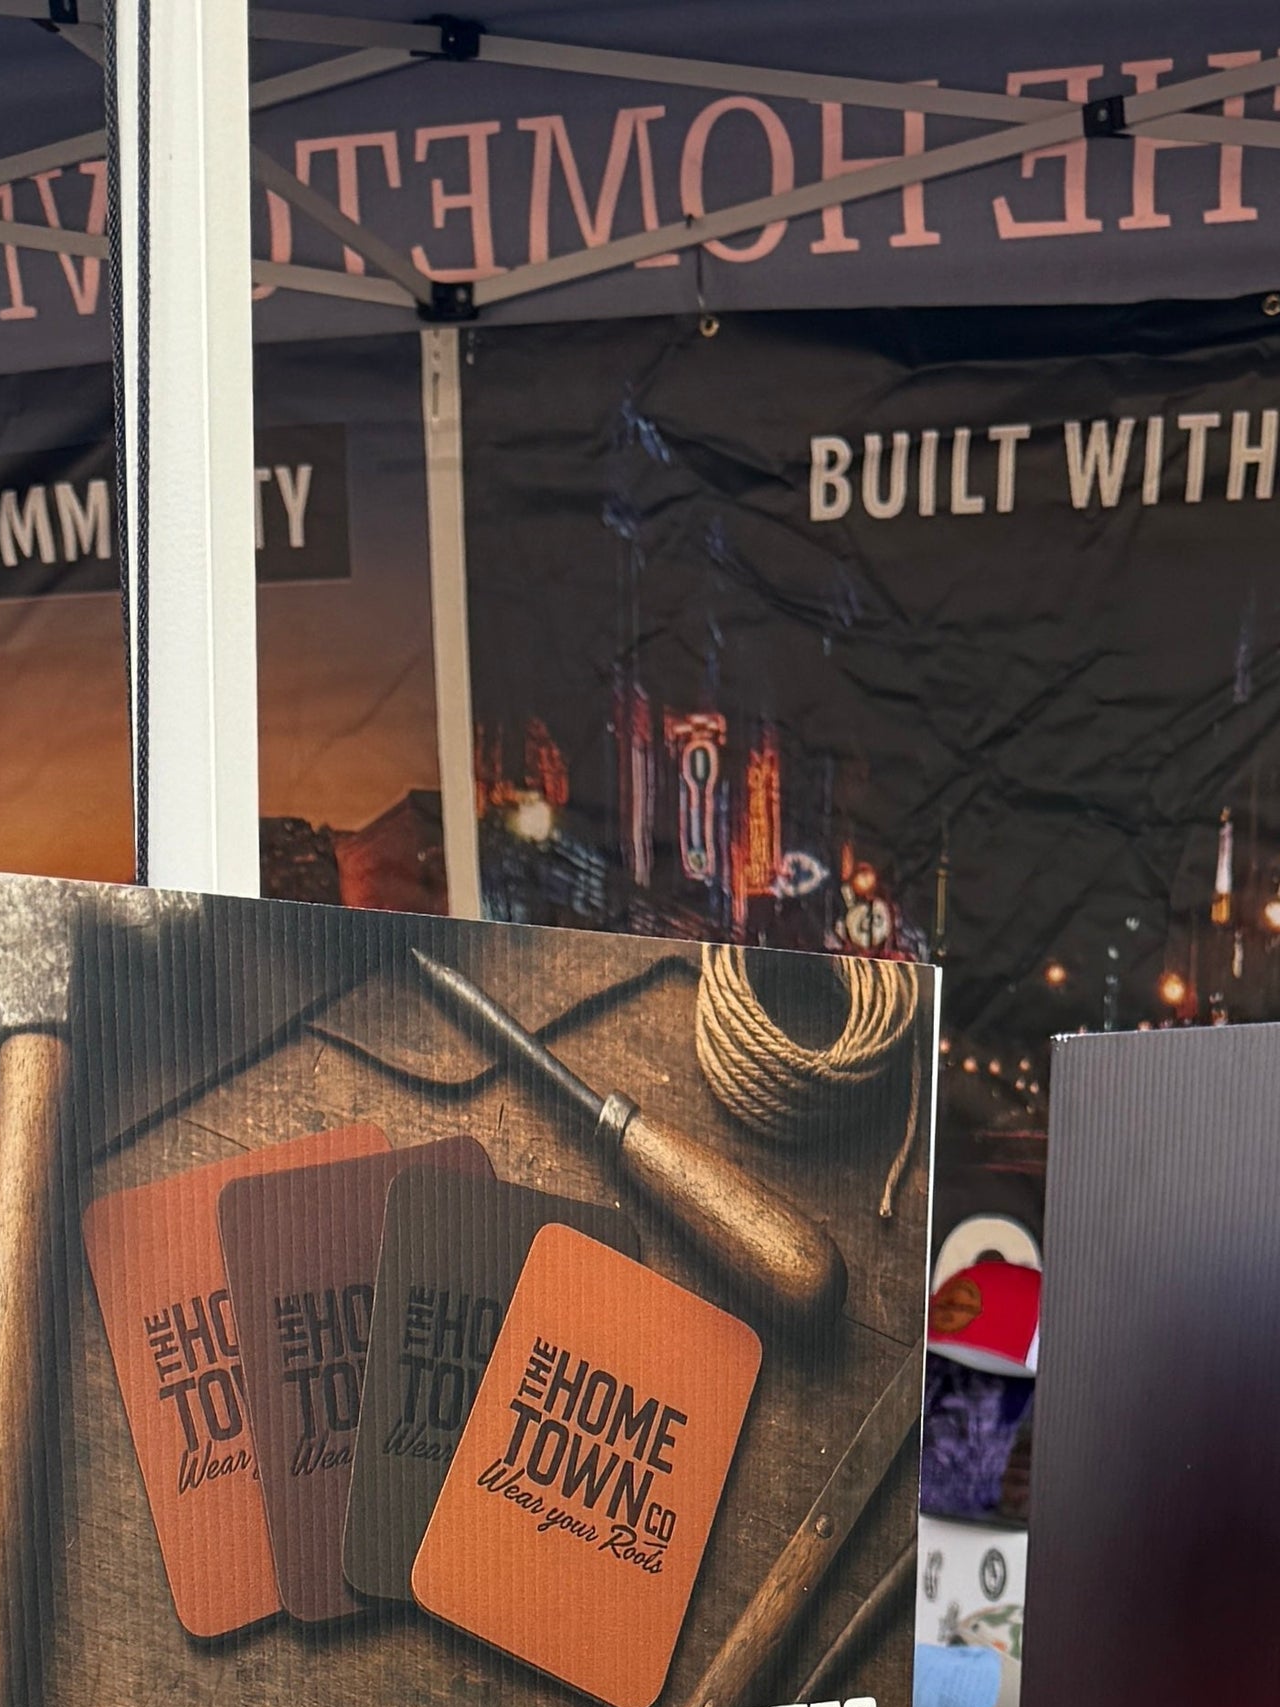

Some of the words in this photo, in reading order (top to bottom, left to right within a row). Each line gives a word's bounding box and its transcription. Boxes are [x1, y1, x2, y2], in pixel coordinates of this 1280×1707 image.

[810, 424, 1031, 521] BUILT
[1063, 409, 1278, 511] WITH
[144, 1308, 183, 1382] THE
[172, 1289, 240, 1373] HO
[303, 1284, 375, 1360] HO
[433, 1290, 503, 1364] HO
[284, 1361, 366, 1440] TO
[399, 1354, 486, 1431] TO
[517, 1336, 558, 1399] THE
[160, 1365, 250, 1452] TO
[543, 1350, 688, 1474] HOME
[179, 1440, 252, 1495] Wear
[291, 1437, 354, 1477] Wea
[503, 1398, 655, 1528] TOWN
[644, 1502, 677, 1549] CO
[477, 1458, 545, 1514] Wear
[537, 1507, 599, 1542] your
[598, 1524, 663, 1574] Roots
